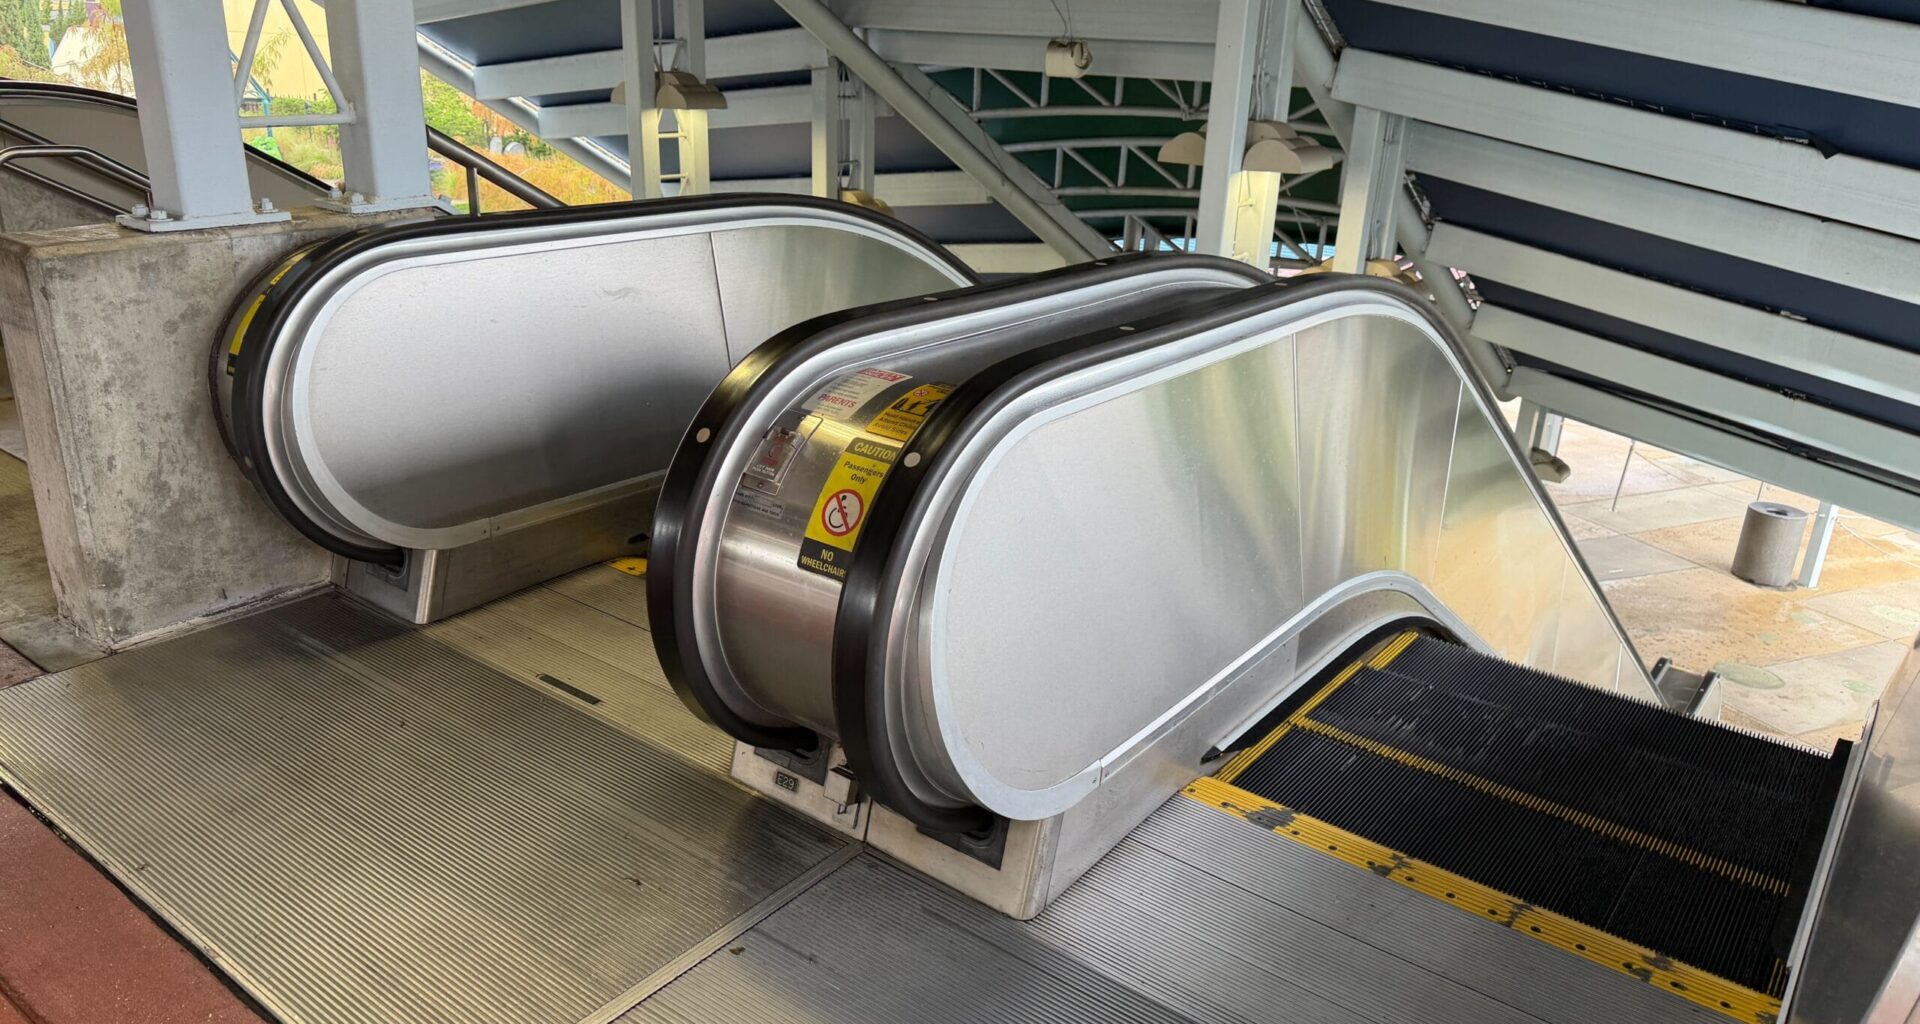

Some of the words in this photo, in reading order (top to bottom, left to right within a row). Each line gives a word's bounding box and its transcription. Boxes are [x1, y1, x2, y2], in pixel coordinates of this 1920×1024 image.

[819, 394, 857, 408] PARENTS
[854, 442, 897, 462] CAUTION
[843, 460, 884, 478] Passengers
[851, 473, 868, 485] Only
[821, 548, 834, 562] NO
[778, 773, 795, 790] E29
